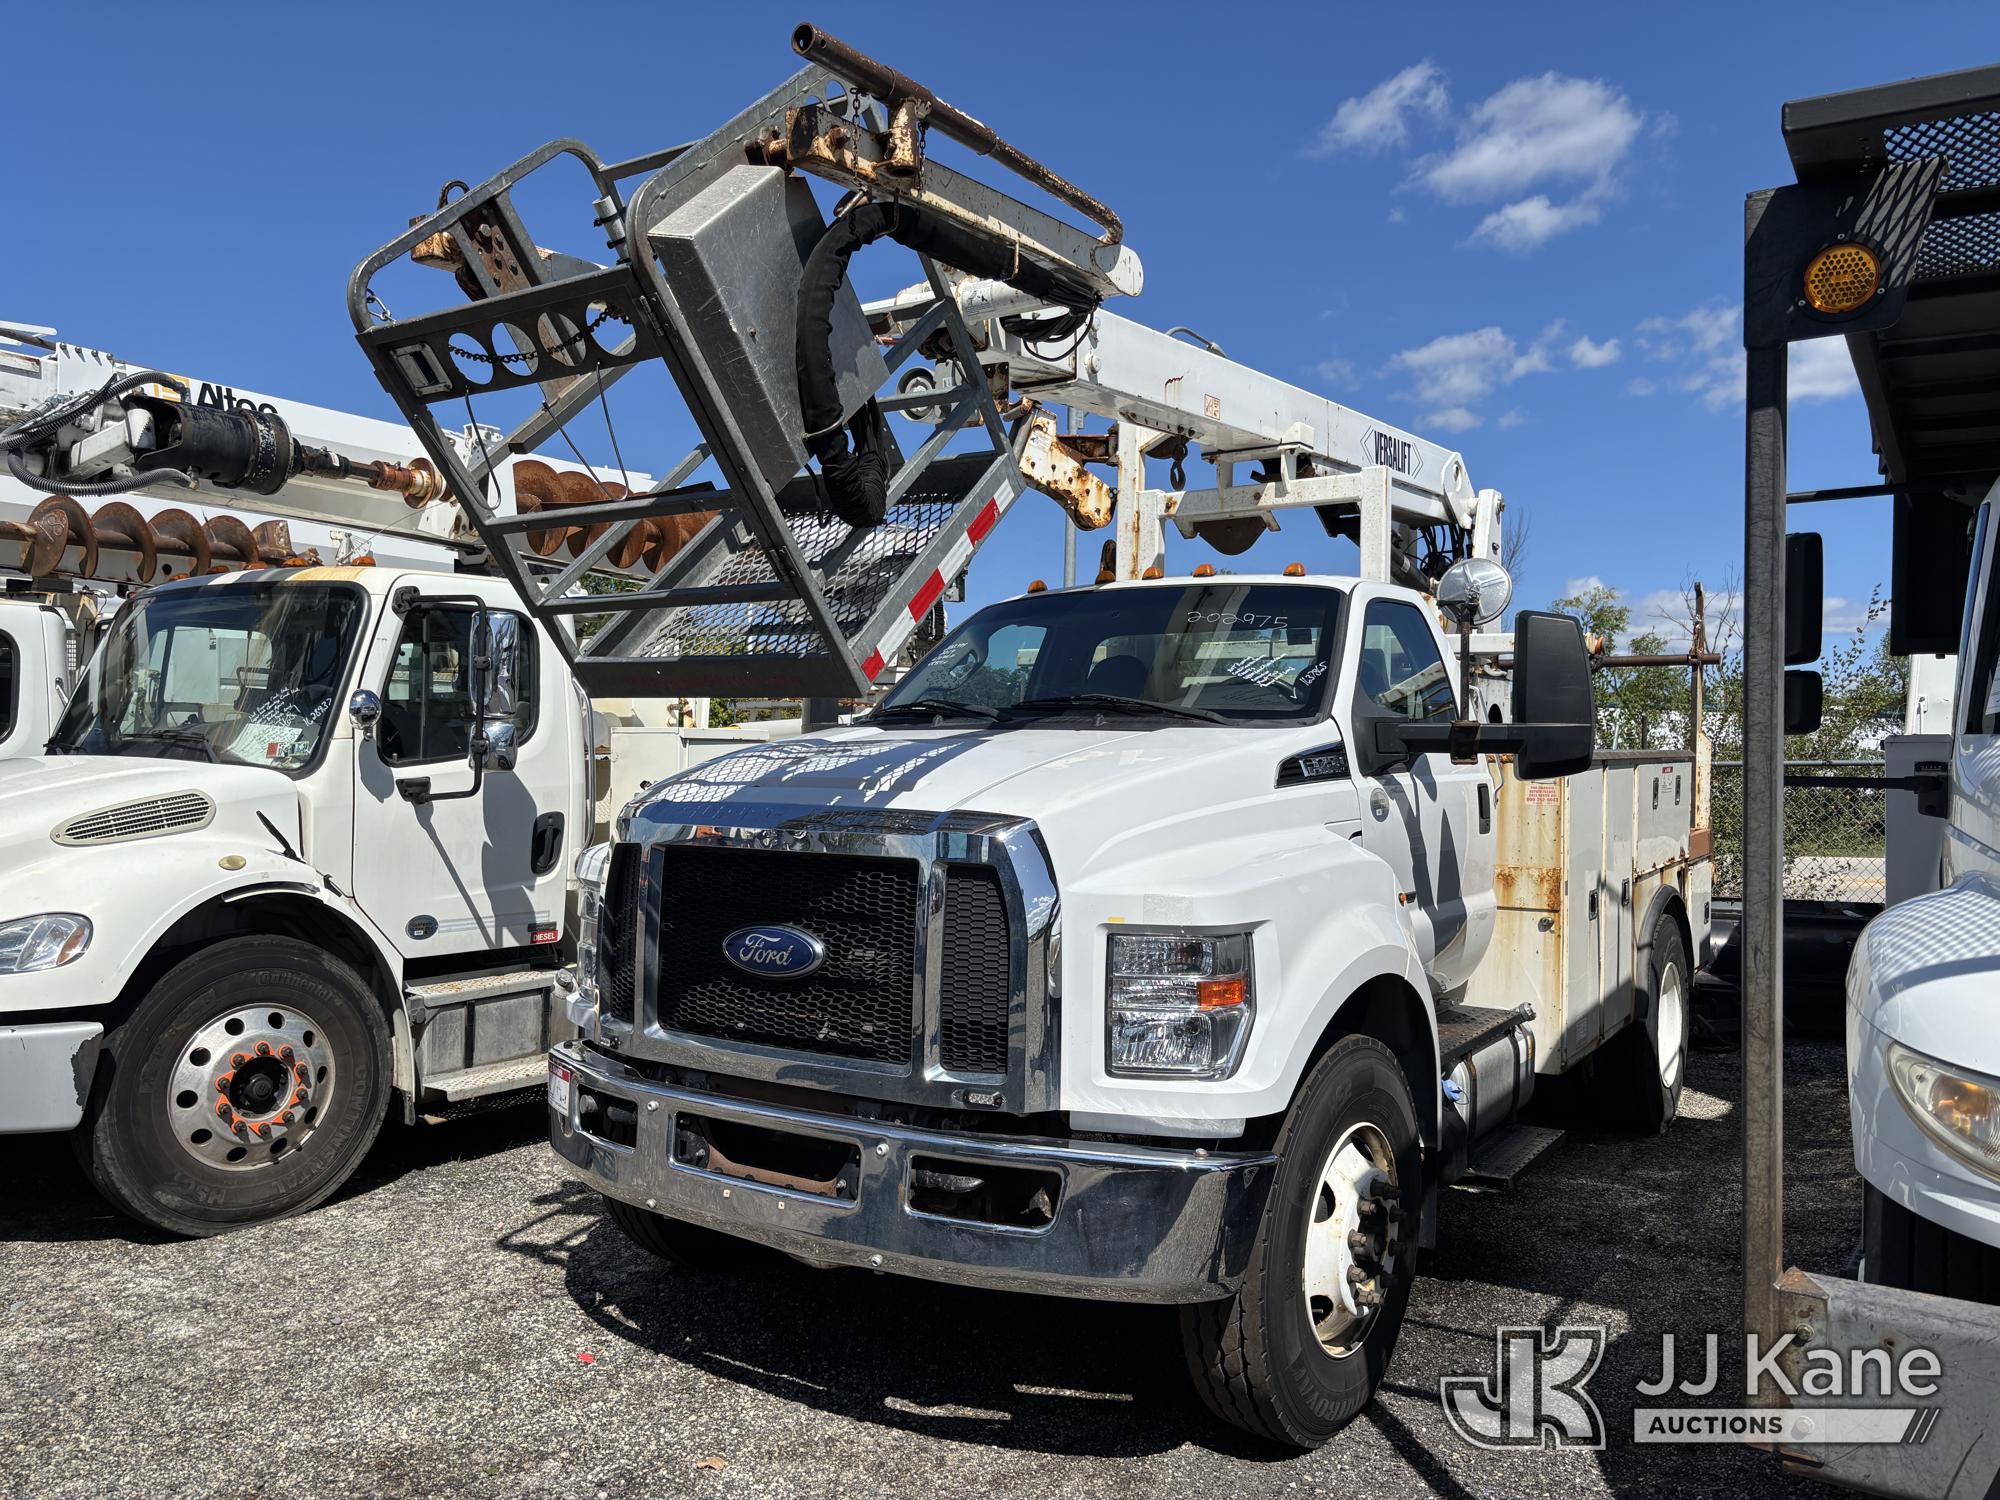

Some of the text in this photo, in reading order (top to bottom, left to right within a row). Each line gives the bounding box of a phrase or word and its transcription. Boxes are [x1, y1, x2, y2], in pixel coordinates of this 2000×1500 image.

[1375, 430, 1411, 475] VERSALIFT
[533, 932, 555, 941] DIESEL
[739, 933, 794, 965] Ford
